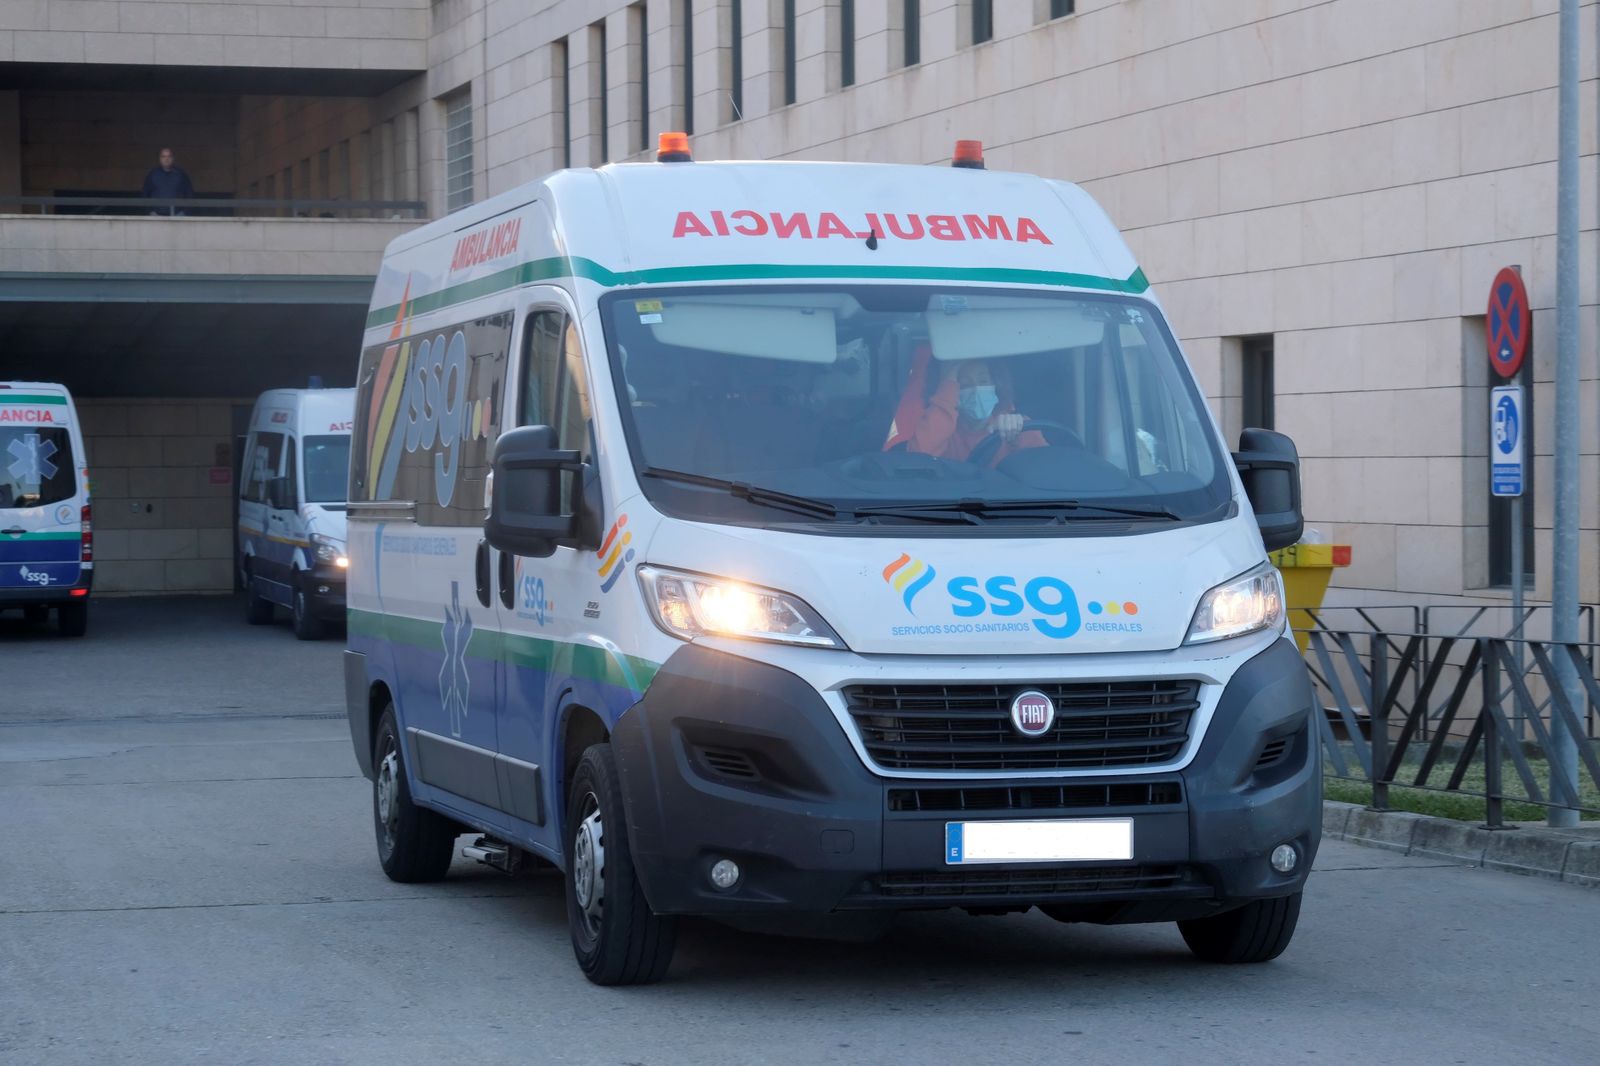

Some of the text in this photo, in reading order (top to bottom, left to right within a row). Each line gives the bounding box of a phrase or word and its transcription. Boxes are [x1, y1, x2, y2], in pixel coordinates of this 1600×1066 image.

[448, 217, 522, 273] AMBULANCIA
[892, 622, 1143, 636] SERVICIOS SOCIO SANITARIOS GENERALES
[1022, 704, 1046, 724] FIAT
[951, 847, 959, 857] E
